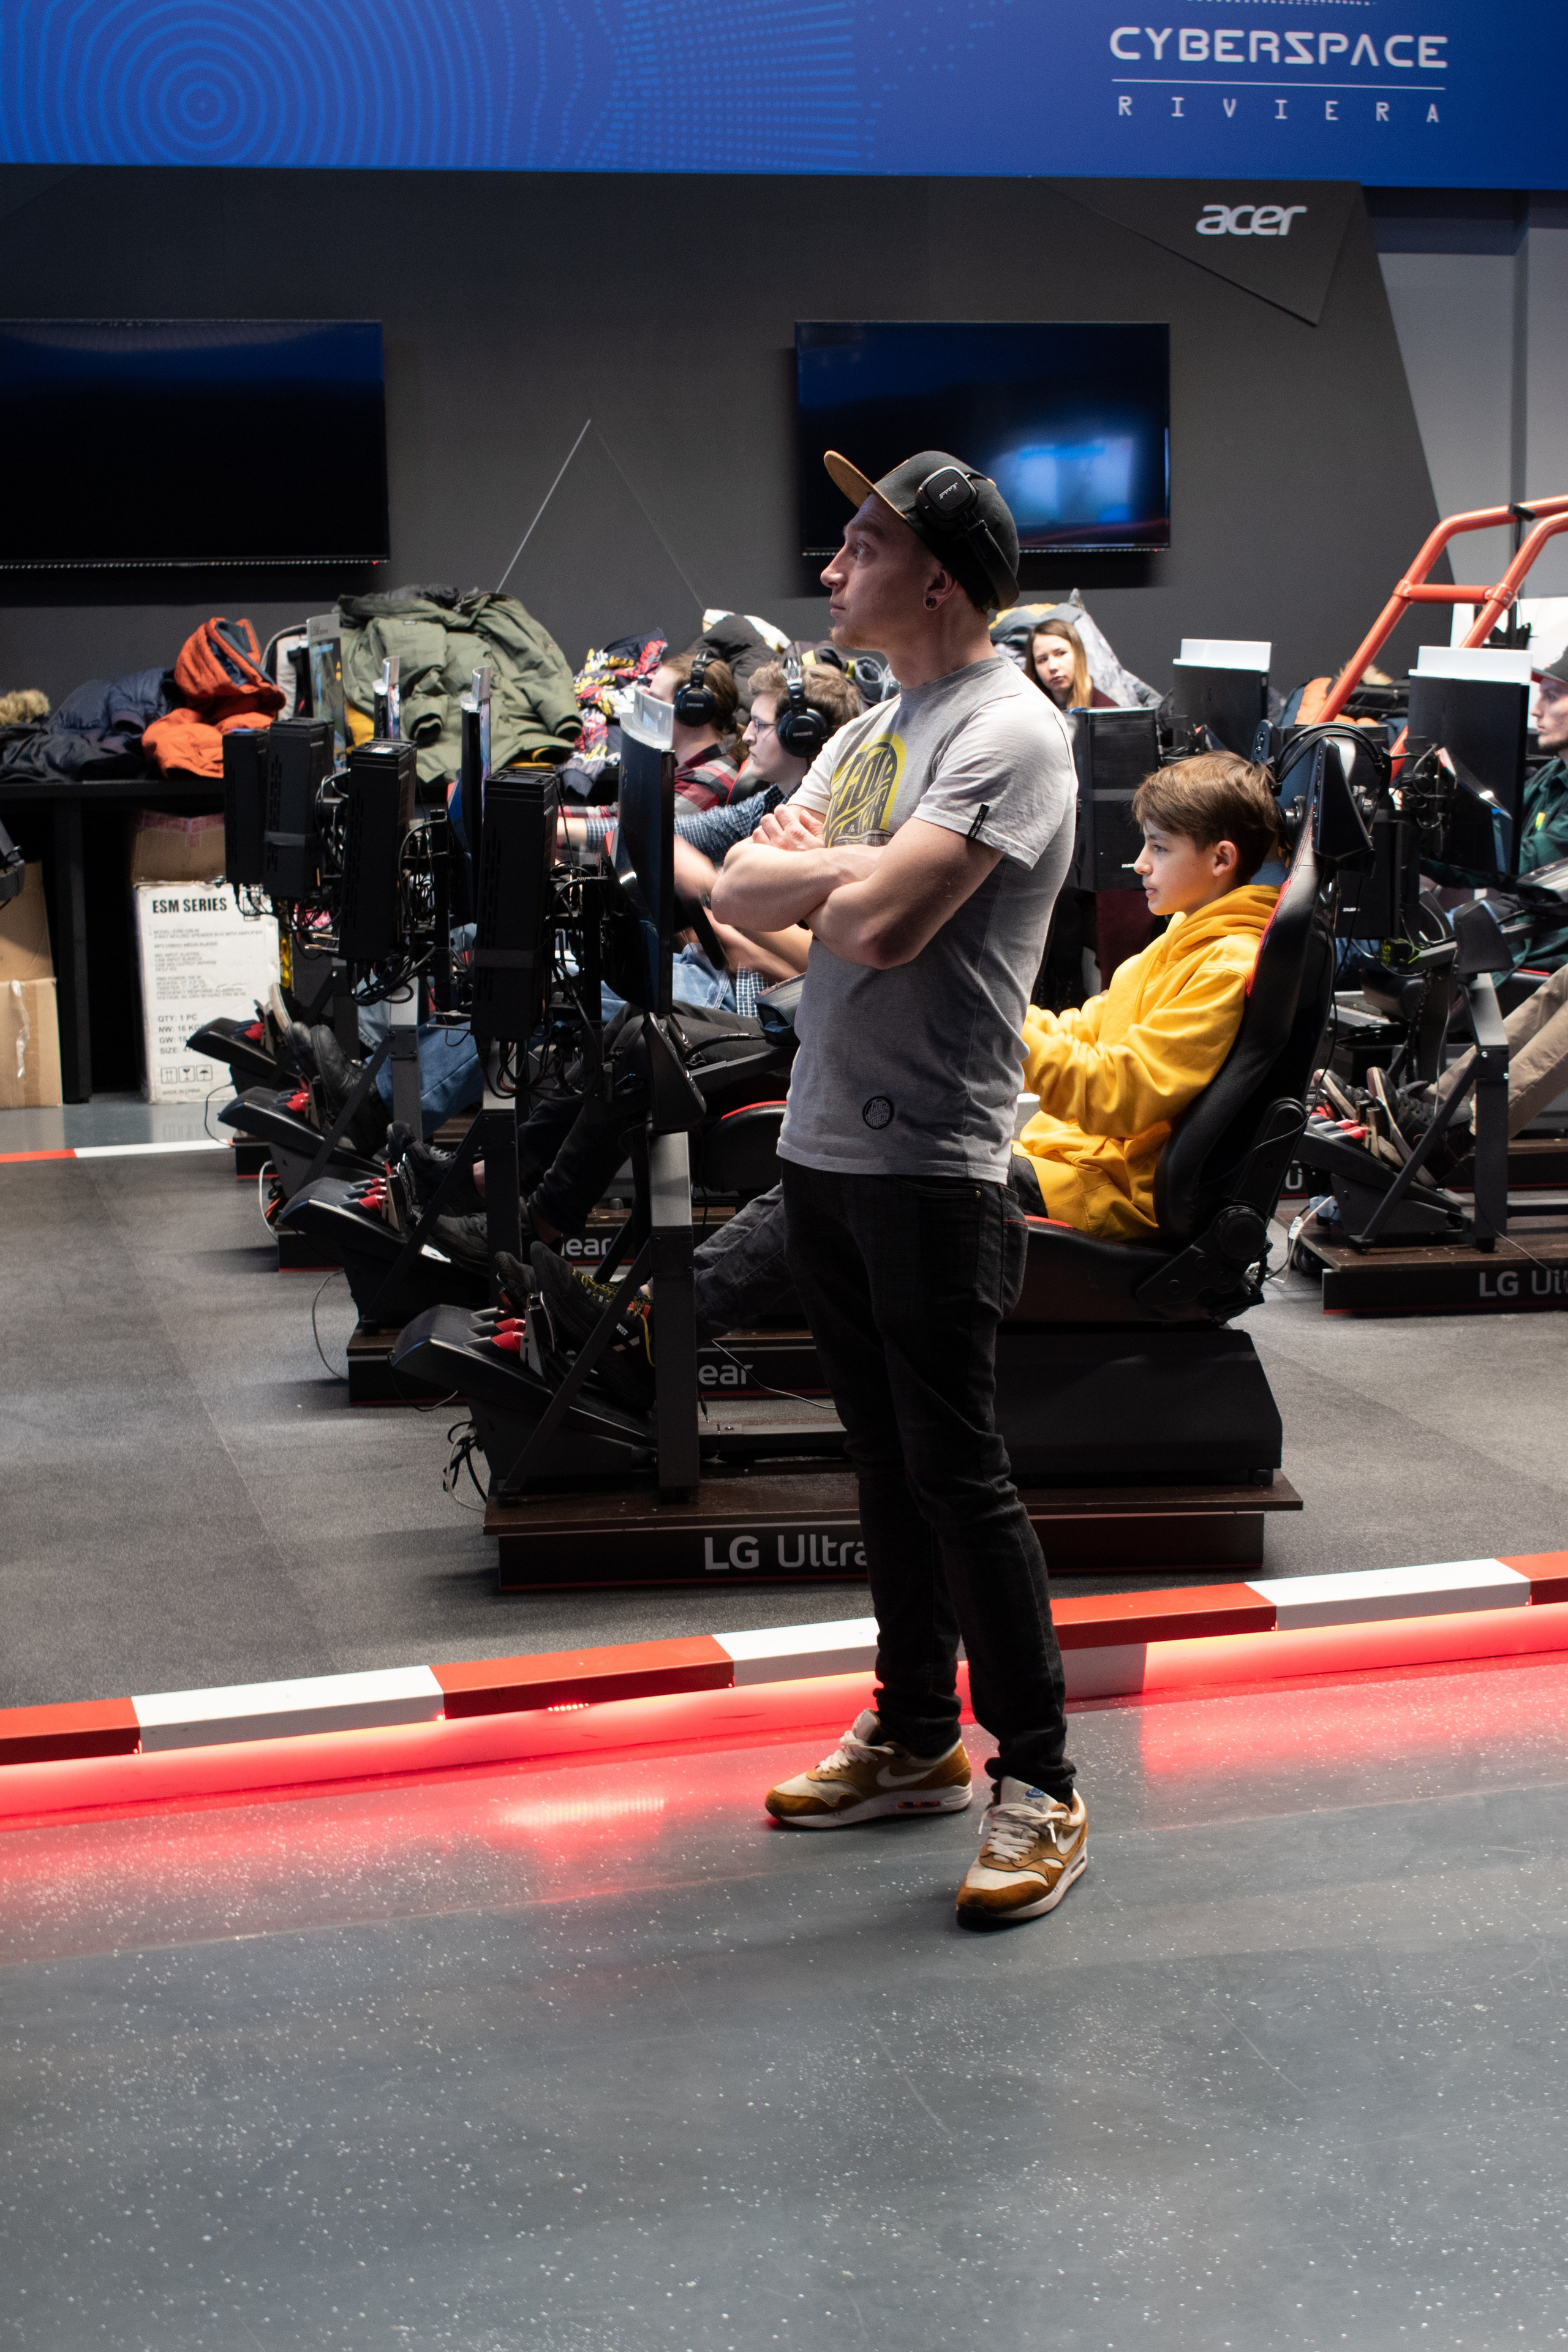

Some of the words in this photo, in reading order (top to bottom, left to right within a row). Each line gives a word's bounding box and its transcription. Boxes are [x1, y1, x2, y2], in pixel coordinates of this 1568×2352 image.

[1109, 26, 1449, 69] CYBERSPACE
[1118, 96, 1439, 123] RIVIERA
[1195, 204, 1307, 236] acer
[153, 899, 179, 913] ESM
[183, 898, 227, 912] SERIES
[1479, 1270, 1519, 1297] LG
[704, 1535, 760, 1570] LG
